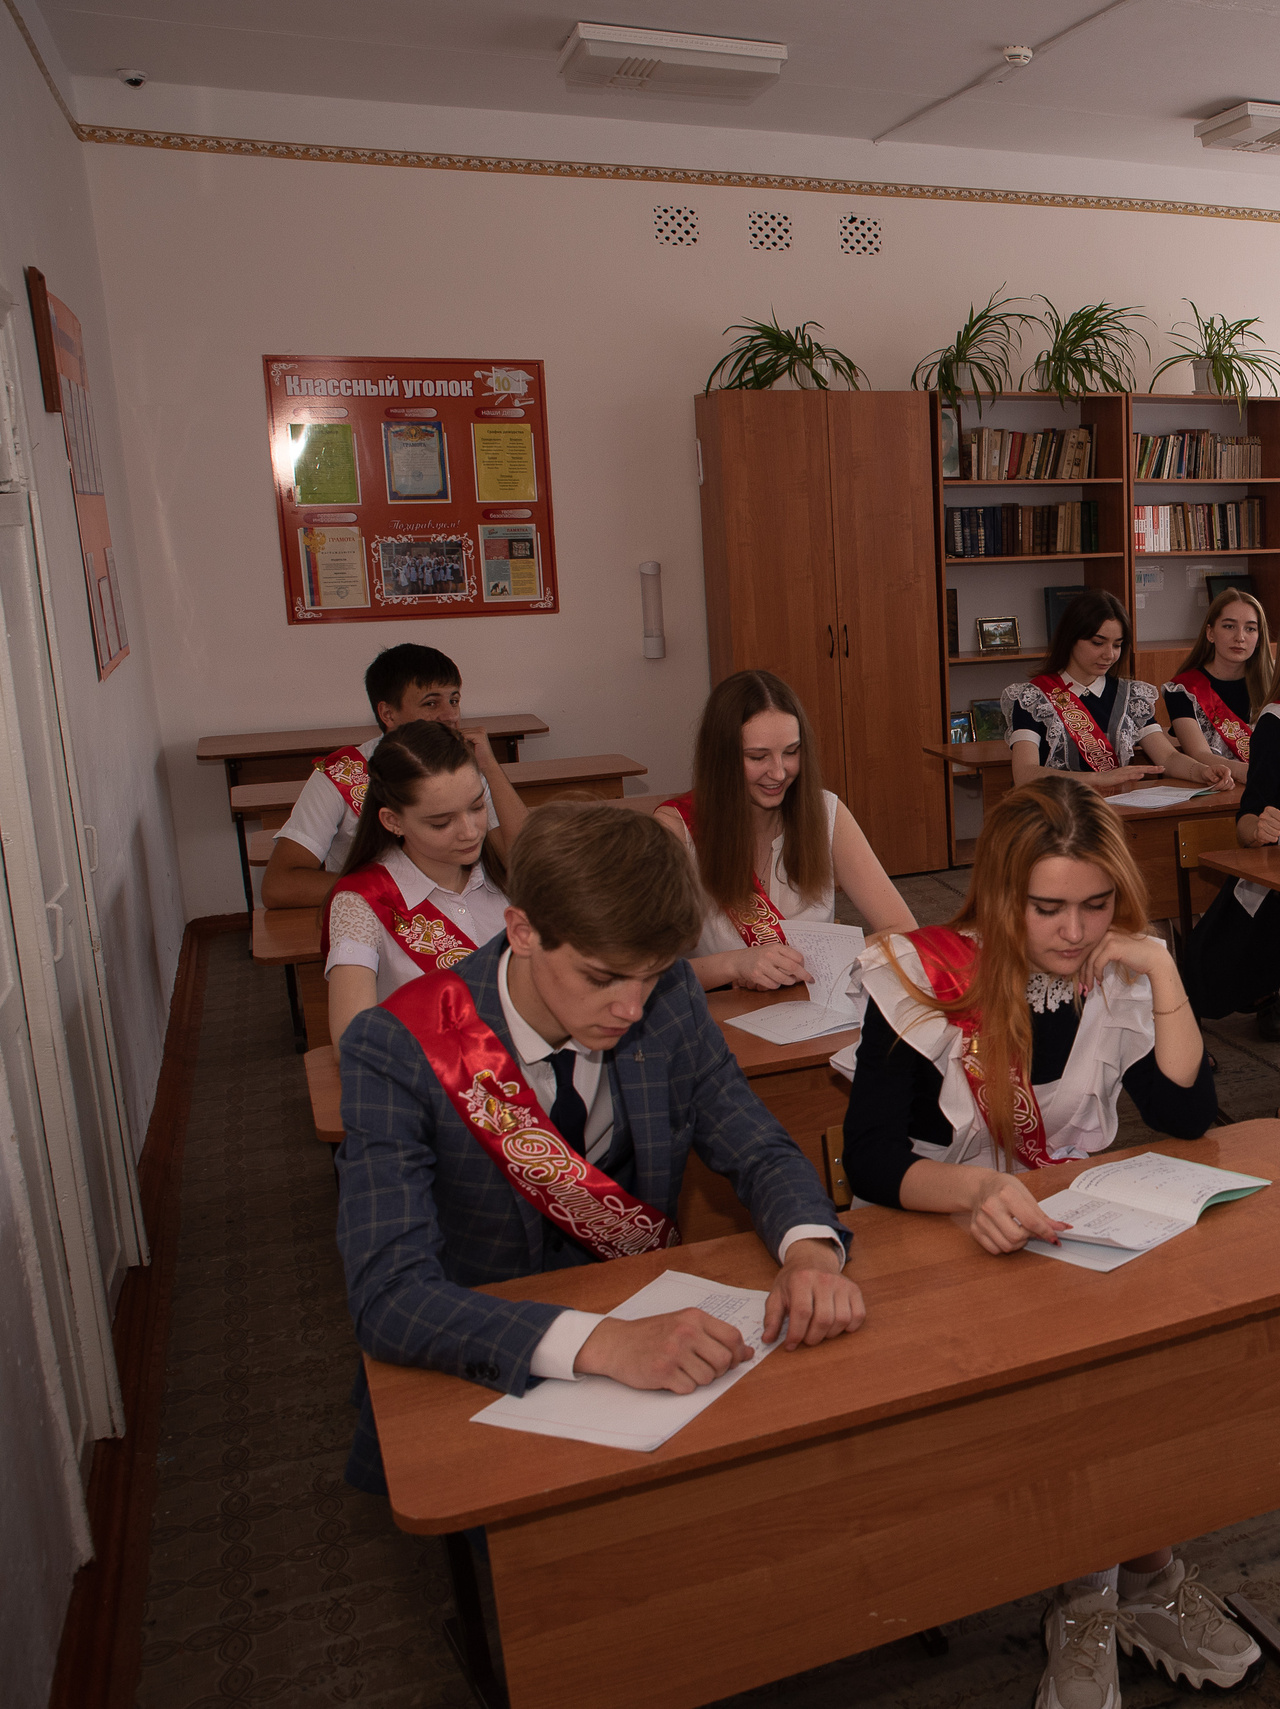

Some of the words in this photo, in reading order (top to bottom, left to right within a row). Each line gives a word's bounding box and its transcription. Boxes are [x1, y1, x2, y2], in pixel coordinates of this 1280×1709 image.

[285, 375, 399, 397] Классный
[403, 378, 474, 400] уголок
[495, 376, 511, 391] 10
